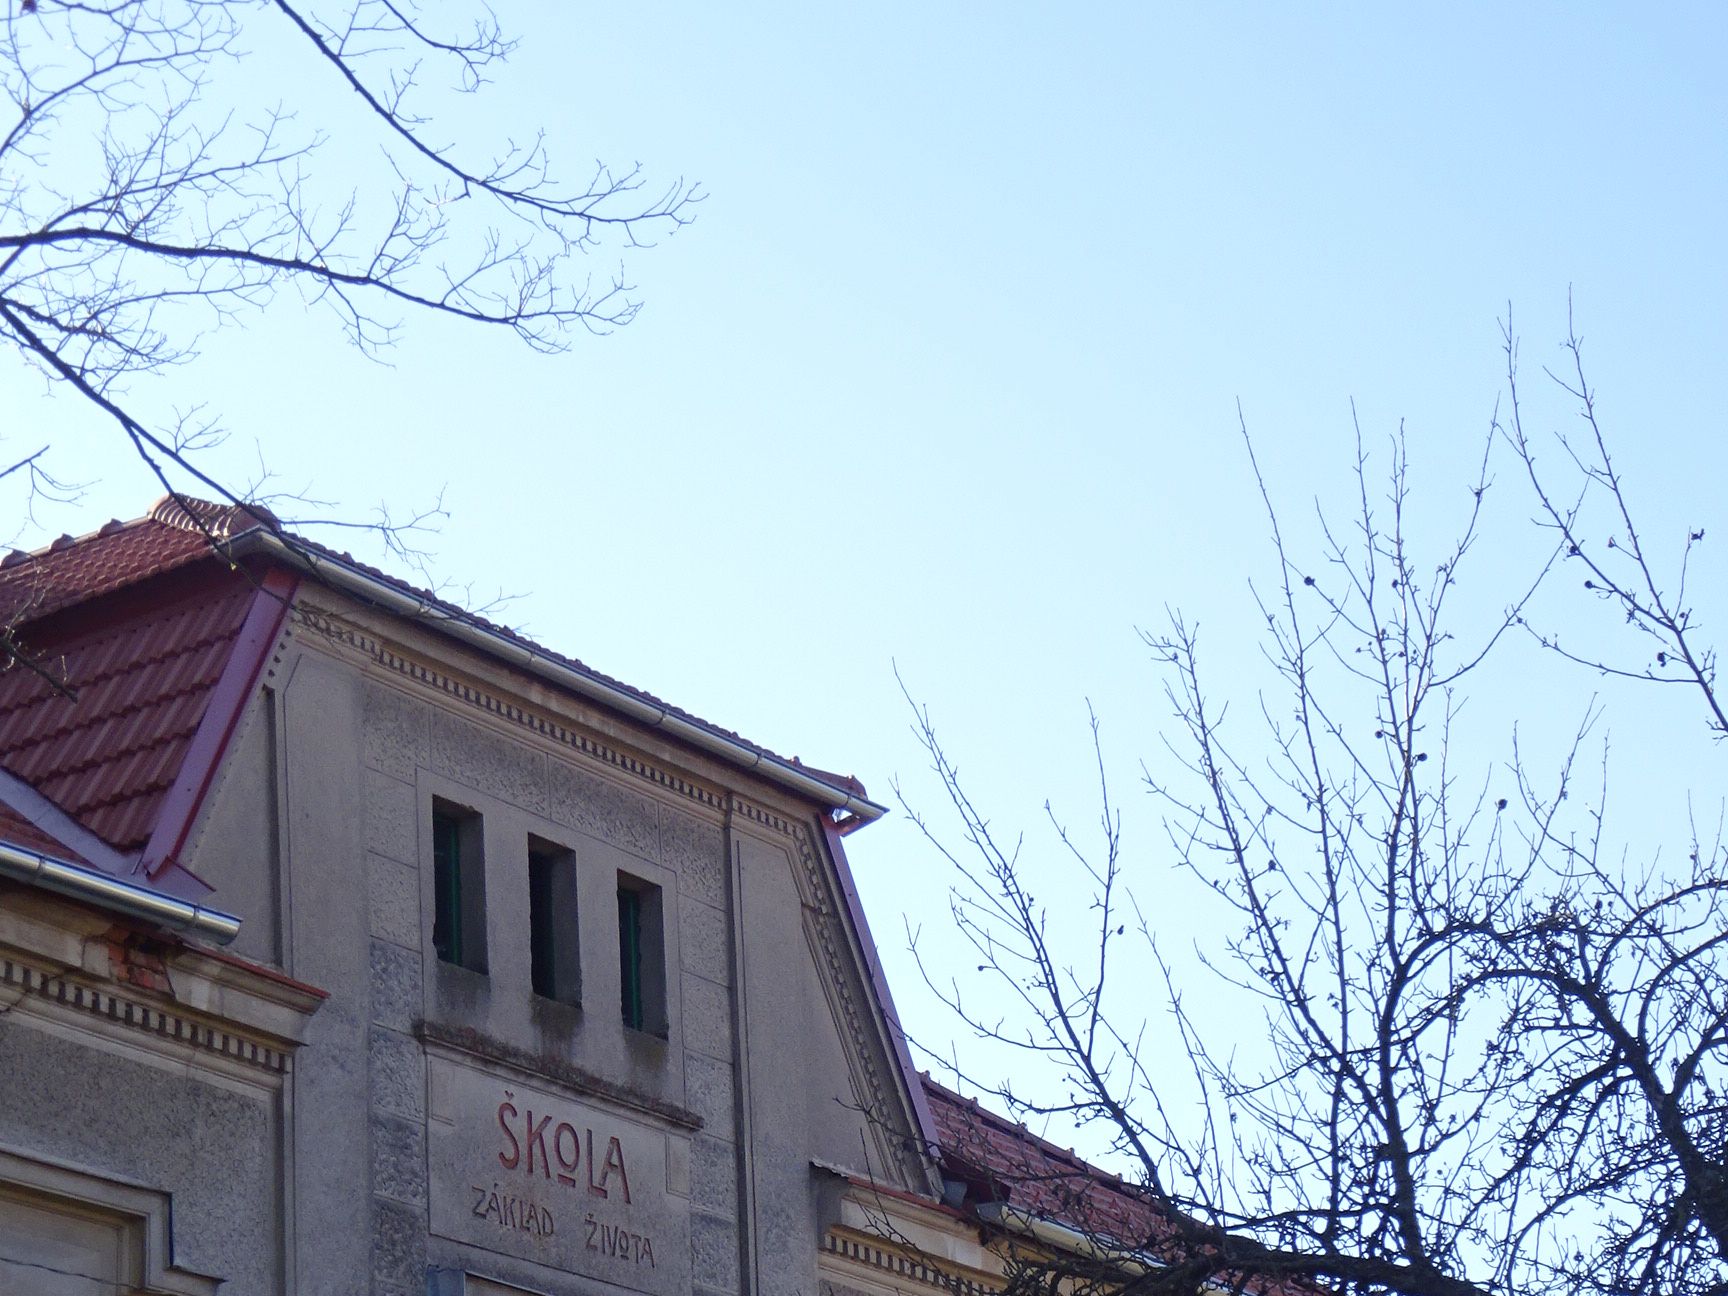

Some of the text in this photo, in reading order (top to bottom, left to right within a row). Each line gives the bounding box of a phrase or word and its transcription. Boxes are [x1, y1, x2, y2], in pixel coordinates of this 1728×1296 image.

[498, 1090, 632, 1204] ŠKOLA
[471, 1183, 655, 1268] ZÁKLAD ŽIVOTA
